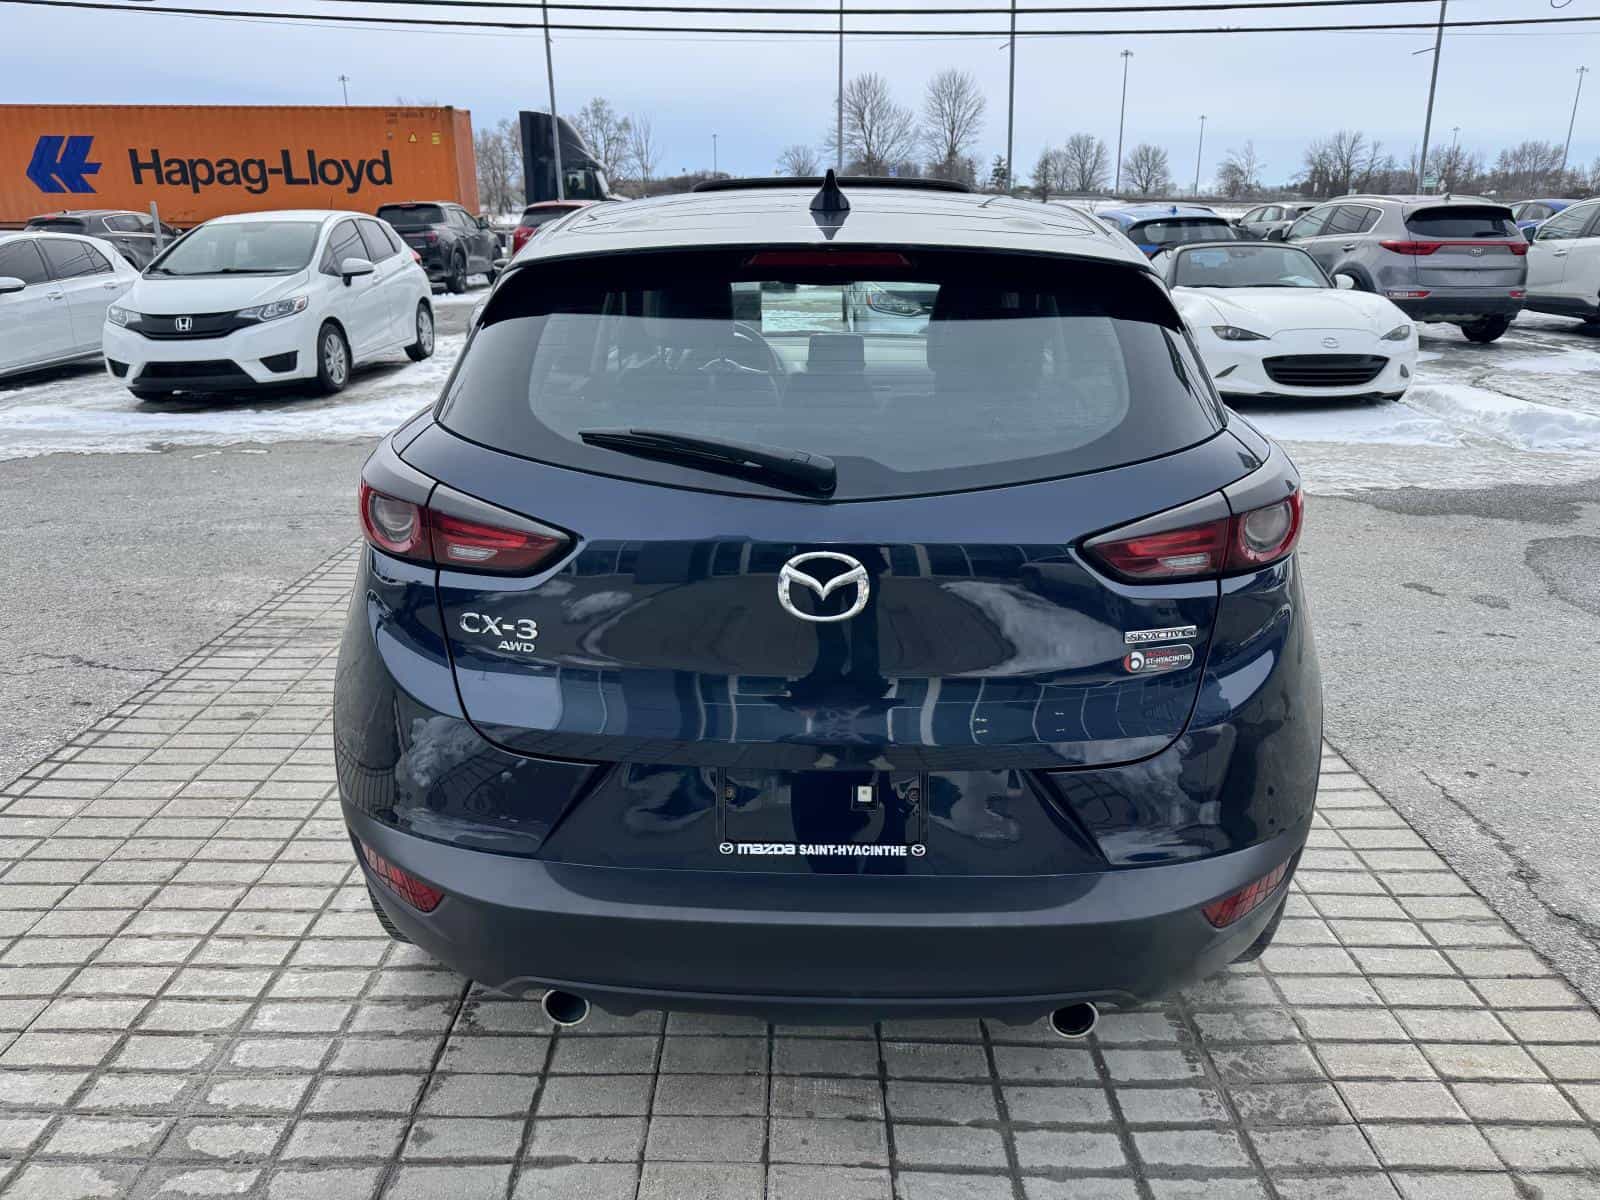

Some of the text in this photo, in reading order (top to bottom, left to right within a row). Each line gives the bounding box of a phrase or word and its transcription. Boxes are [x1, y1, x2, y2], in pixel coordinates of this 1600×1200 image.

[128, 148, 393, 194] Hapag-Lloyd
[460, 611, 539, 640] CX-3
[498, 640, 536, 653] AWD
[799, 844, 908, 856] SAINT-HYACINTHE
